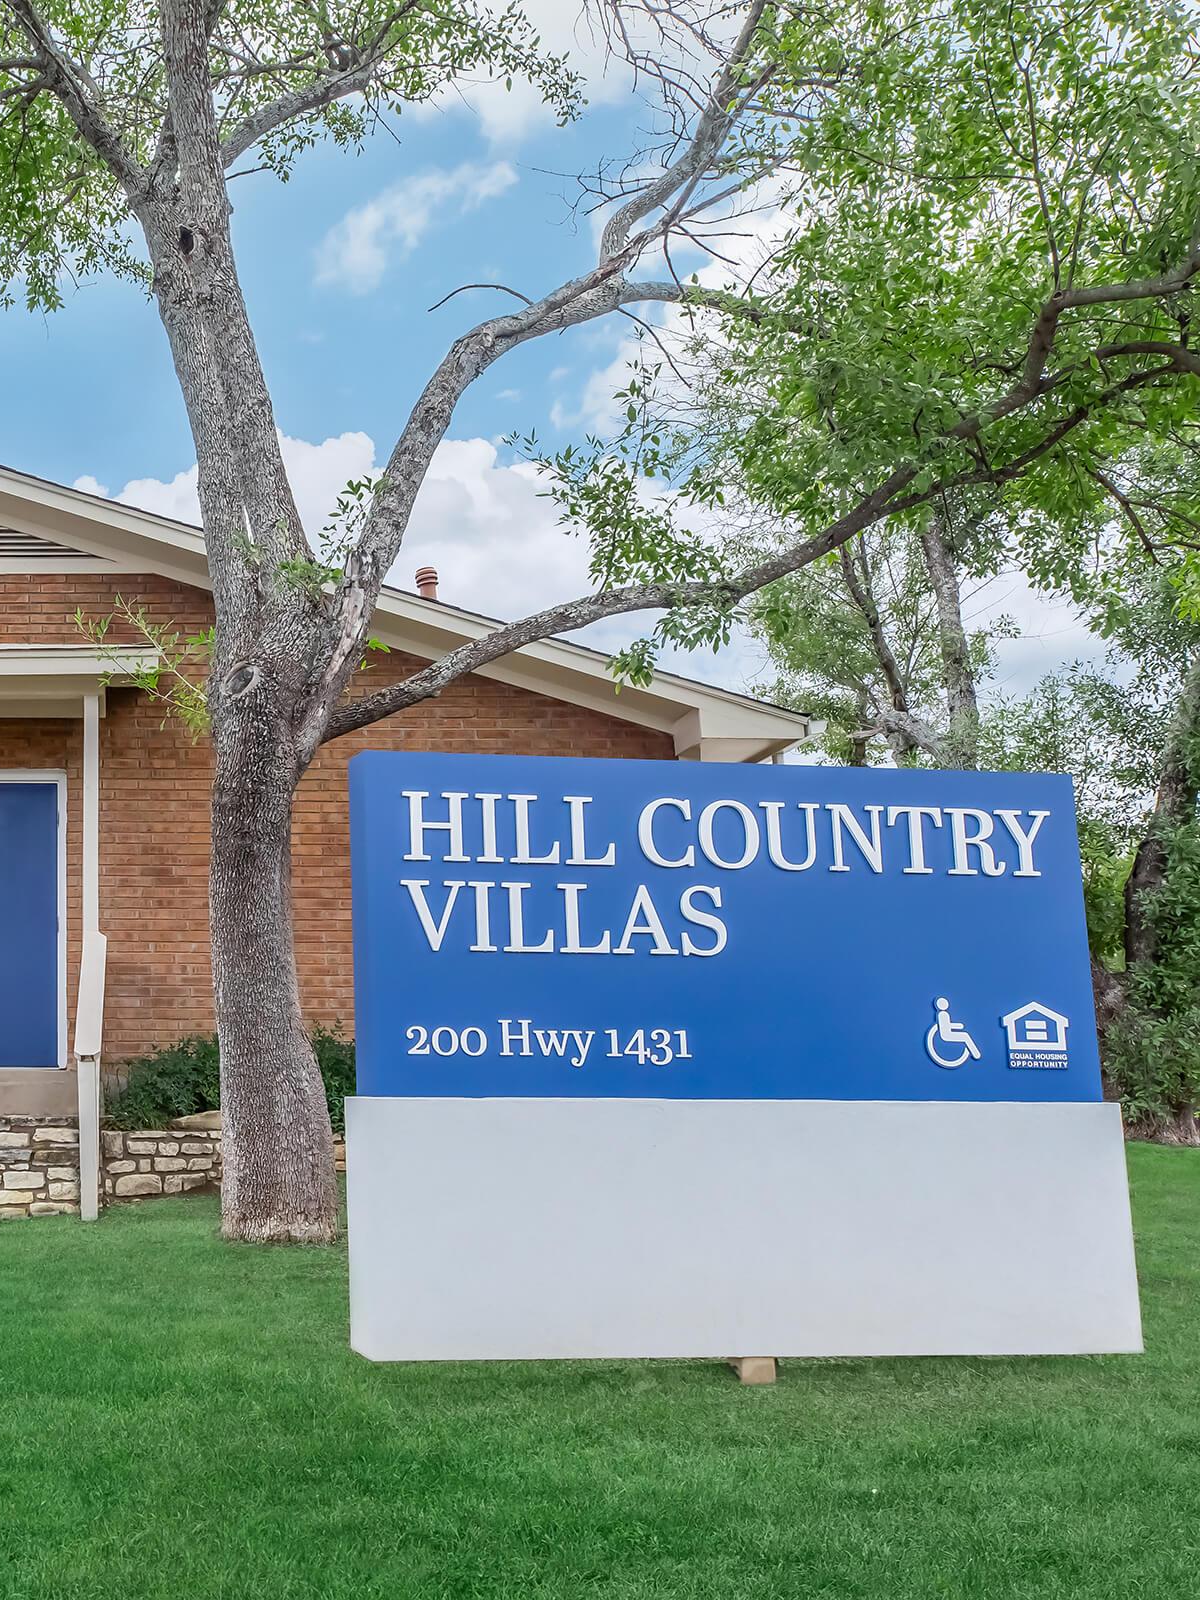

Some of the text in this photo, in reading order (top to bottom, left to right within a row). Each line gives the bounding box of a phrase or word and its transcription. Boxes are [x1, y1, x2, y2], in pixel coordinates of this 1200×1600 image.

[401, 790, 1051, 877] HILL COUNTRY
[400, 879, 728, 957] VILLAS
[406, 1019, 693, 1067] 200 Hwy 1431
[1009, 1052, 1068, 1061] EQUAL HOUSING
[1010, 1060, 1068, 1069] OPPORTUNITY
